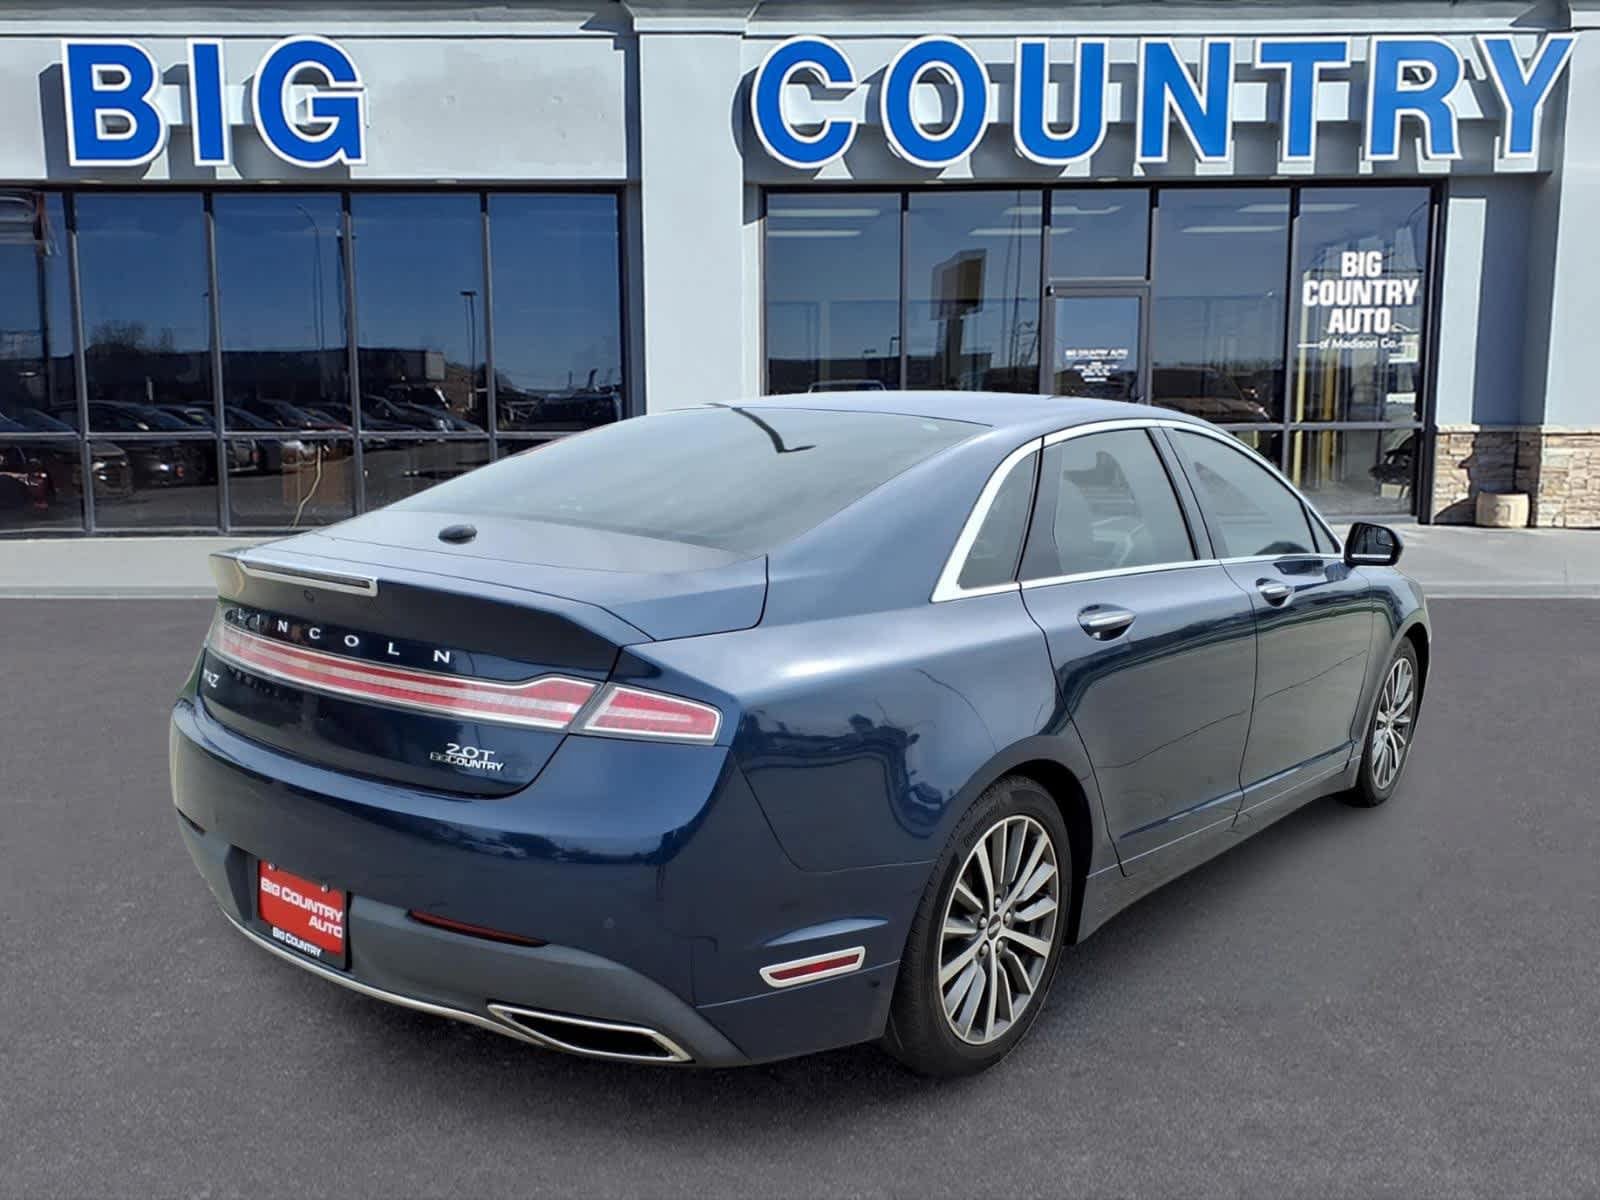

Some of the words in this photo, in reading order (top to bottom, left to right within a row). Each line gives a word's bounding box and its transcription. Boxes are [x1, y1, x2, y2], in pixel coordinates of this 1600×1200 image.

[61, 35, 367, 168] BIG
[750, 34, 1576, 170] COUNTRY
[1341, 251, 1382, 277] BIG
[1302, 279, 1419, 306] COUNTRY
[1327, 307, 1391, 334] AUTO
[1331, 338, 1379, 349] Madison
[236, 607, 451, 664] LINCOLN
[448, 755, 505, 771] COUNTRY
[260, 877, 281, 897] BIG
[281, 887, 344, 922] COUNTRY
[308, 915, 343, 939] AUTO
[286, 932, 322, 957] COUNTRY
